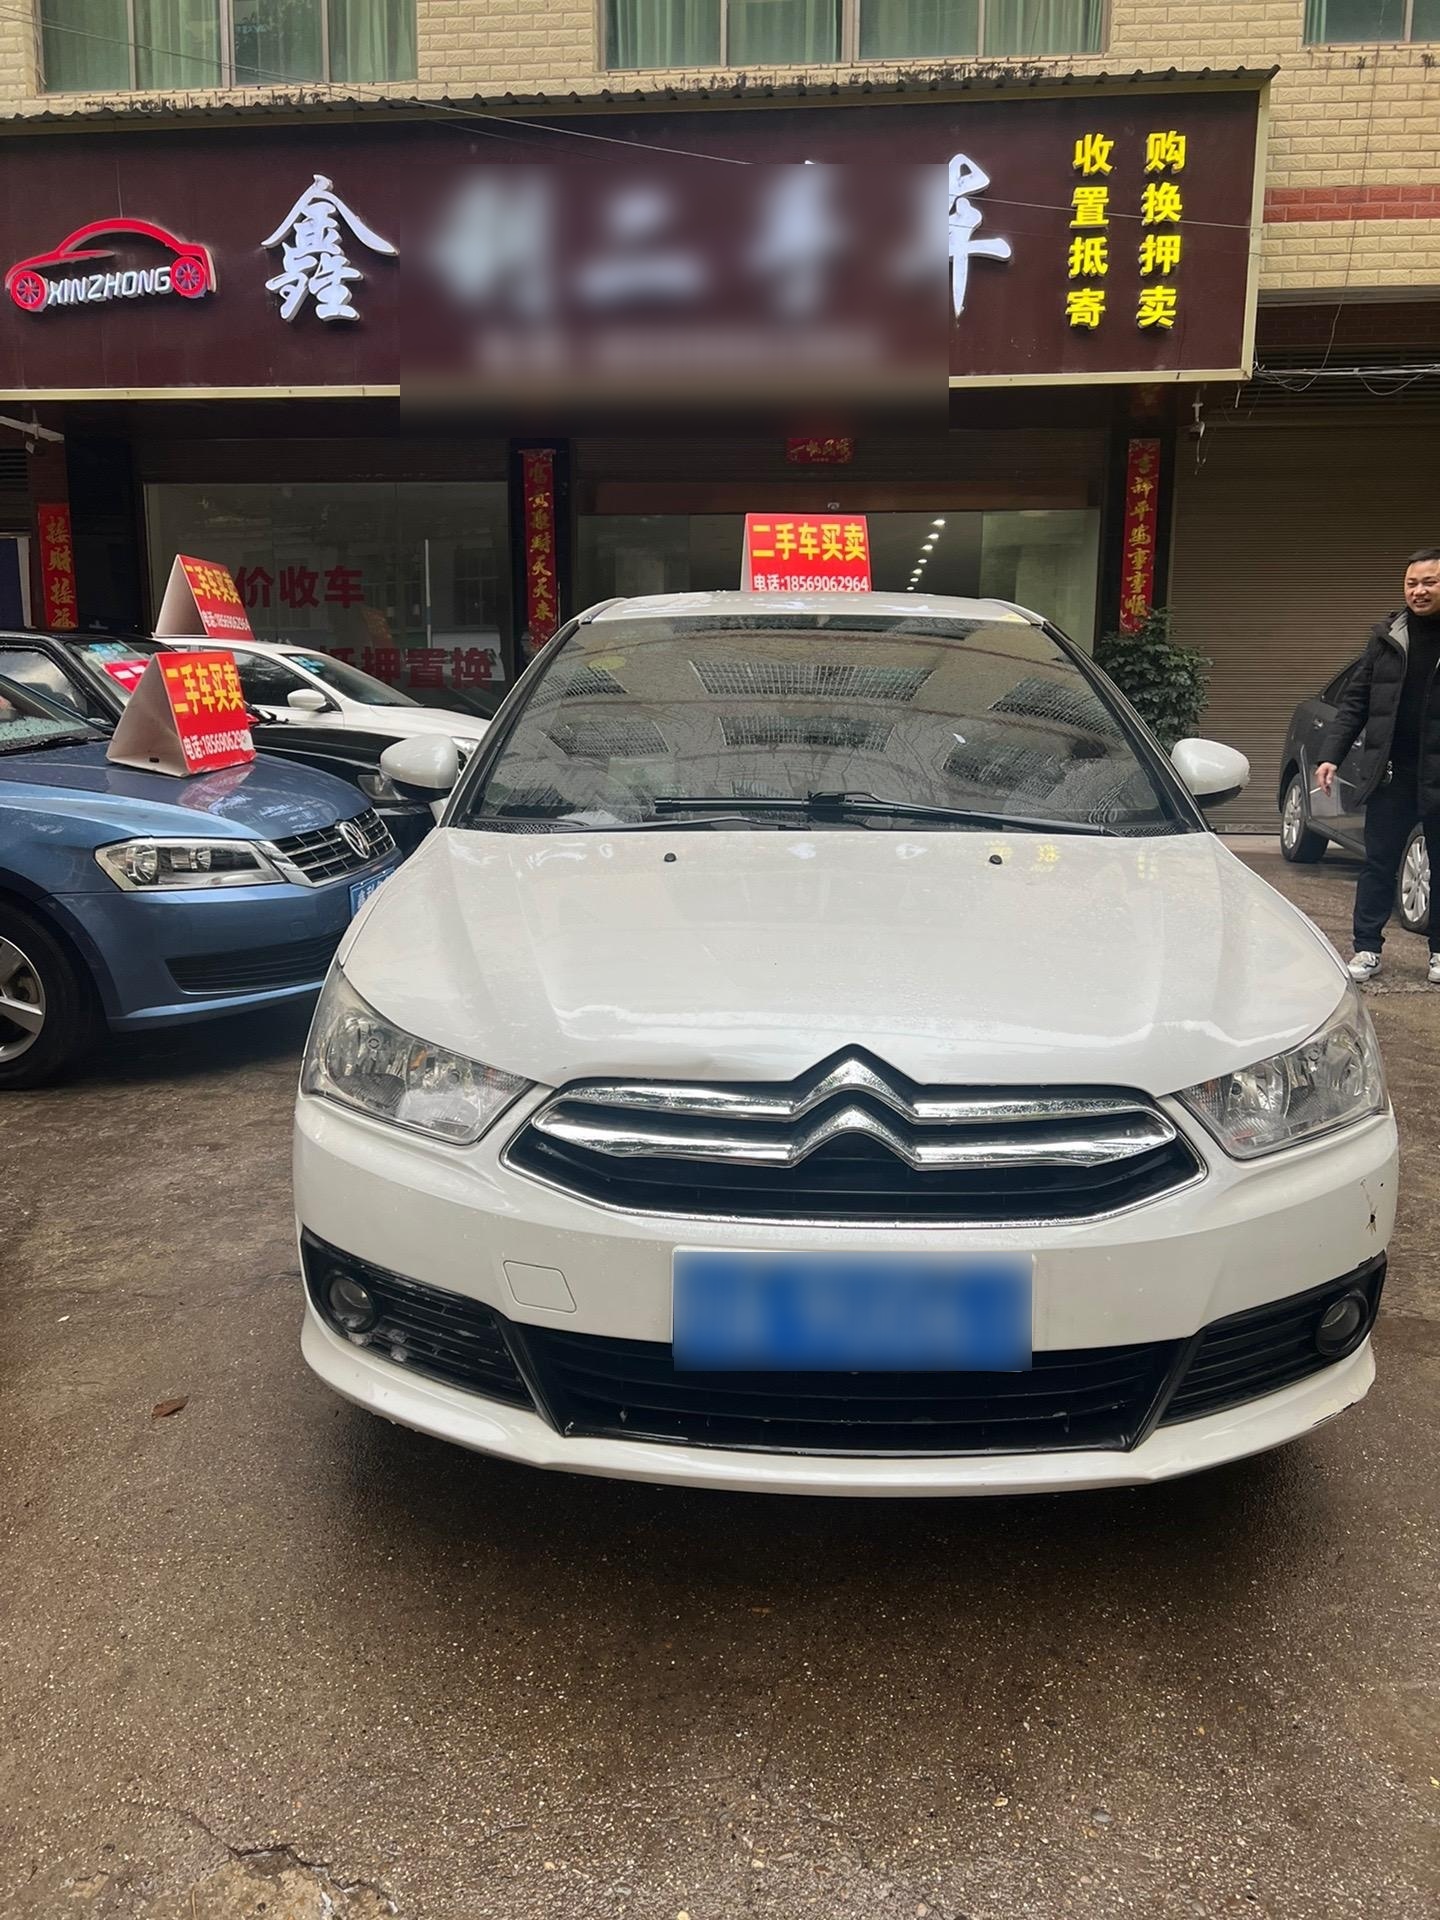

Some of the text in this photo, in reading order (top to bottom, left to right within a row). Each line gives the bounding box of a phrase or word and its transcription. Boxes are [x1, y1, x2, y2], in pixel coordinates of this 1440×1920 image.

[1073, 131, 1186, 175] 收购
[1069, 182, 1183, 228] 置换
[1068, 234, 1181, 278] 抵押
[47, 266, 172, 306] XINZHONG
[1065, 285, 1177, 329] 寄卖
[752, 523, 867, 561] 二手车买卖
[184, 565, 243, 604] 二手车买卖
[165, 661, 244, 715] 二手车买卖
